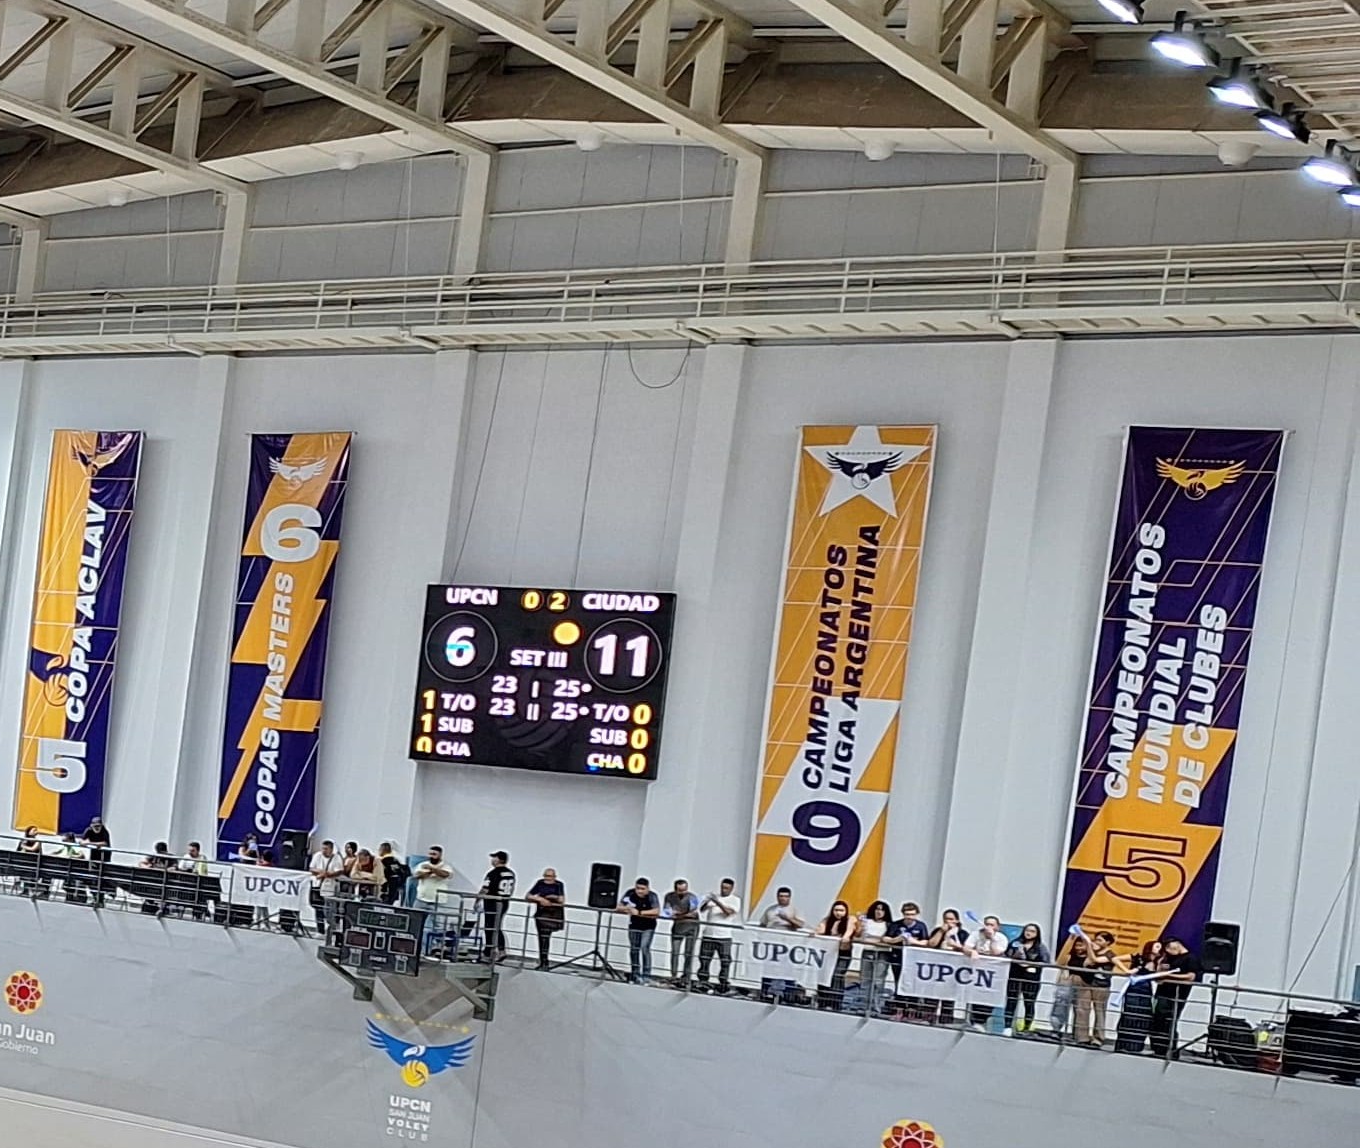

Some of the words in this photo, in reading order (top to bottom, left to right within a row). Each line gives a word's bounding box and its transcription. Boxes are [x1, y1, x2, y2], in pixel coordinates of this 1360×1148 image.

[260, 503, 322, 563] 6
[75, 498, 106, 619] ACLAV
[445, 588, 498, 606] UPCN
[524, 592, 539, 610] 0
[550, 593, 566, 610] 2
[582, 593, 660, 612] CIUDAD
[841, 524, 881, 714] ARGENTINA
[263, 571, 294, 721] MASTERS
[445, 626, 476, 667] 6
[594, 634, 650, 677] 11
[510, 649, 545, 667] SET
[547, 650, 568, 668] III
[65, 626, 92, 723] COPA
[802, 543, 848, 791] CAMPEONATOS
[1106, 522, 1166, 800] CAMPEONATOS
[1181, 603, 1227, 747] CLUBES
[423, 690, 436, 710] 1
[441, 692, 477, 711] T/O
[491, 676, 518, 694] 23
[531, 681, 539, 698] I
[421, 713, 433, 733] 1
[437, 716, 474, 733] SUB
[488, 697, 516, 716] 23
[527, 703, 539, 721] II
[593, 703, 630, 722] T/O
[633, 704, 652, 724] 0
[1137, 636, 1186, 805] MUNDIAL
[416, 737, 432, 753] 0
[436, 741, 470, 757] CHA
[589, 729, 628, 746] SUB
[630, 729, 649, 749] 0
[36, 738, 87, 794] 5
[586, 753, 625, 770] CHA
[628, 753, 646, 774] 0
[826, 715, 858, 794] LIGA
[255, 729, 280, 833] COPAS
[1173, 748, 1202, 809] DE
[790, 800, 862, 866] 9
[1100, 830, 1187, 903] 5
[245, 877, 301, 896] UPCN
[752, 941, 827, 969] UPCN
[915, 962, 996, 988] UPCN
[15, 1024, 55, 1044] Juan
[389, 1095, 431, 1113] UPCN
[386, 1127, 428, 1141] CLUB
[387, 1117, 430, 1131] VOLEY
